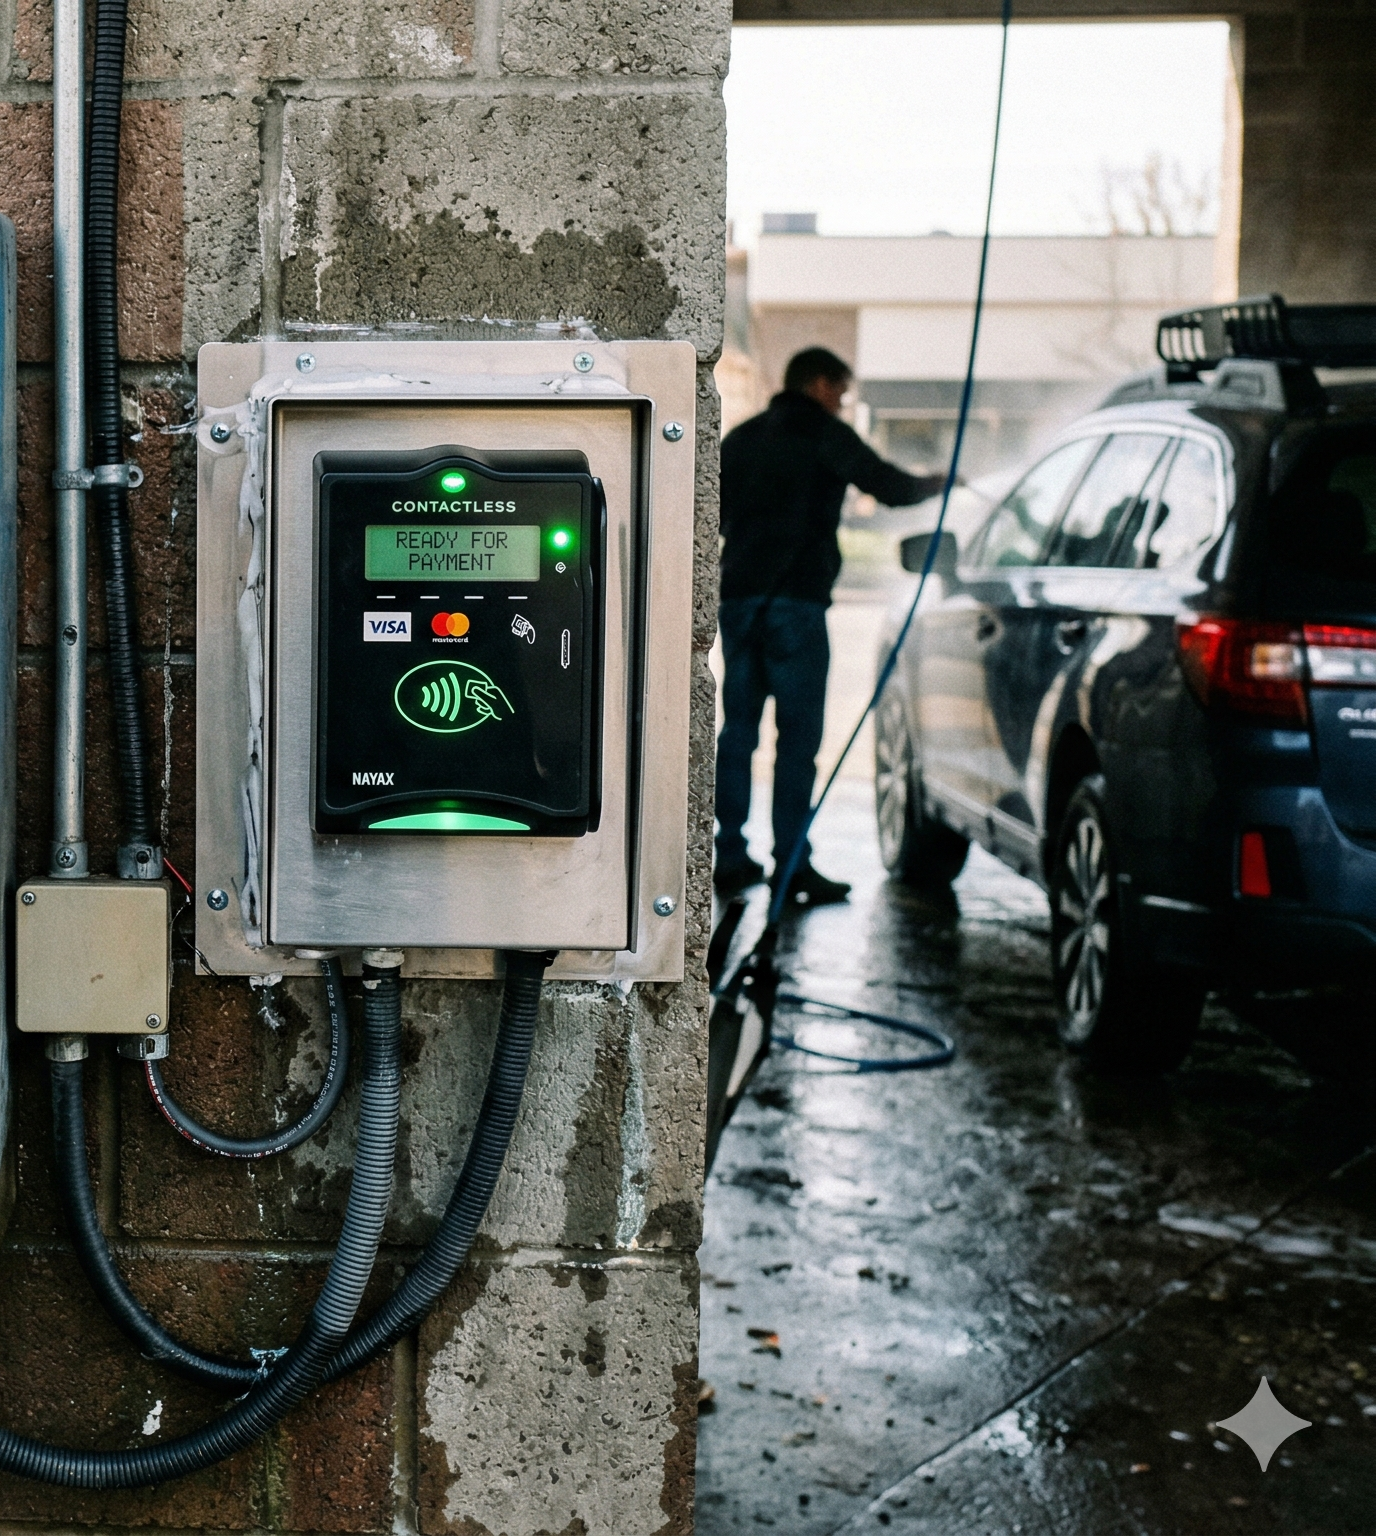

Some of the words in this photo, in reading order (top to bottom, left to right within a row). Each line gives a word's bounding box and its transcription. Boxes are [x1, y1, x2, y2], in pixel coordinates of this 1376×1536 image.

[392, 500, 517, 514] CONTACTLESS
[396, 531, 458, 550] READY
[471, 531, 508, 550] FOR
[409, 553, 495, 571] PAYMENT
[369, 620, 408, 634] VISA
[352, 772, 395, 786] NAYAX
